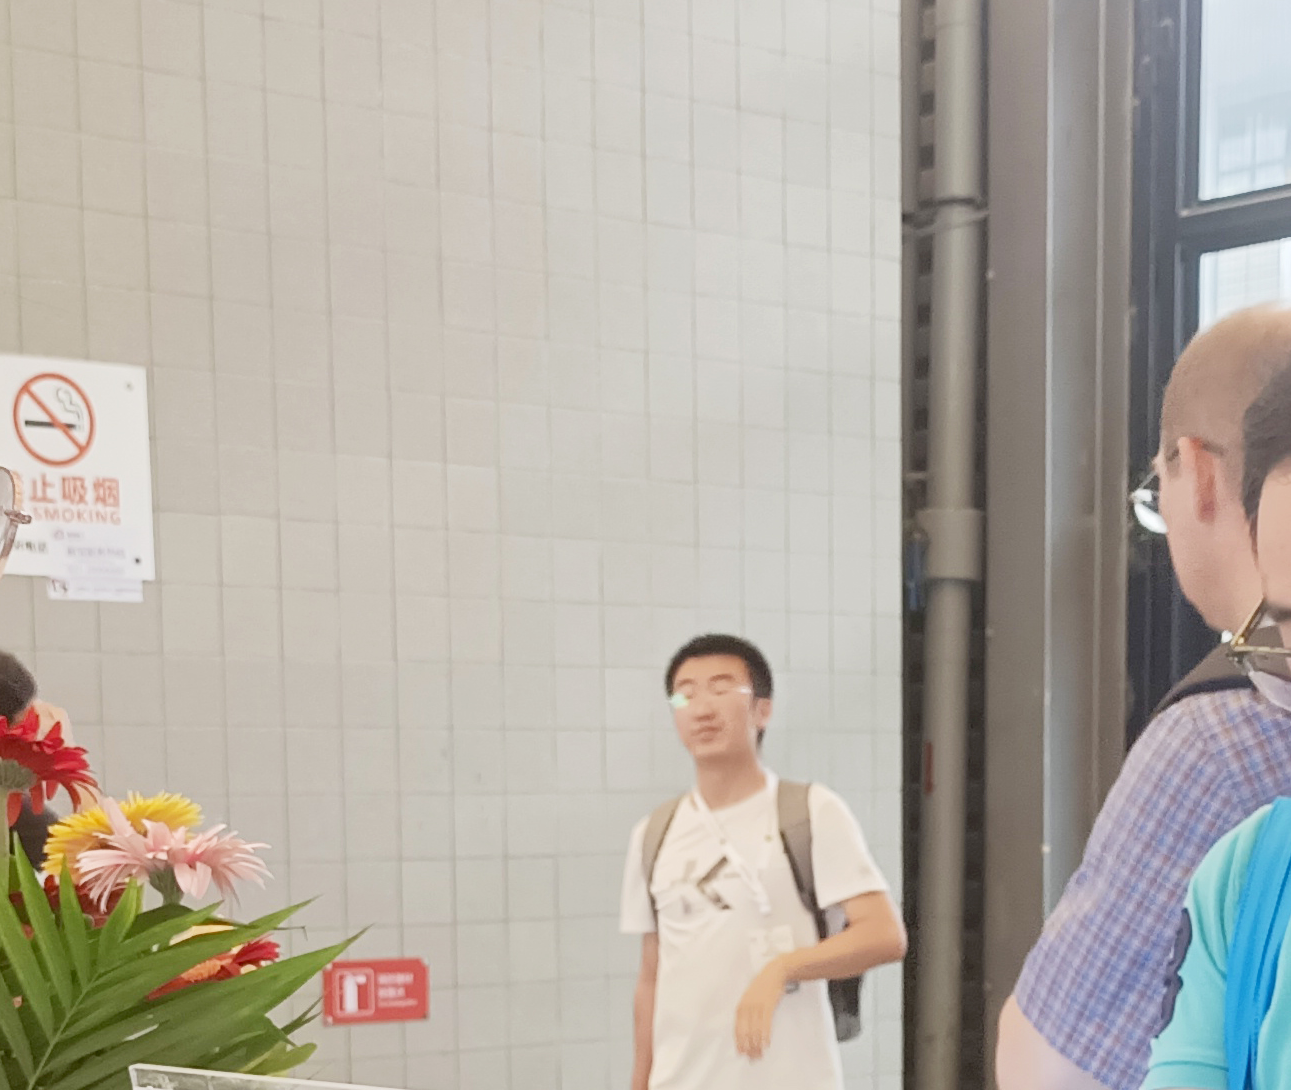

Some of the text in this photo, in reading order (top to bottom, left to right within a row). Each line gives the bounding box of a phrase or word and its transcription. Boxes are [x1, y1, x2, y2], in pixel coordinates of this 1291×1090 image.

[13, 472, 120, 508] 止吸烟
[32, 506, 121, 526] SMOKING
